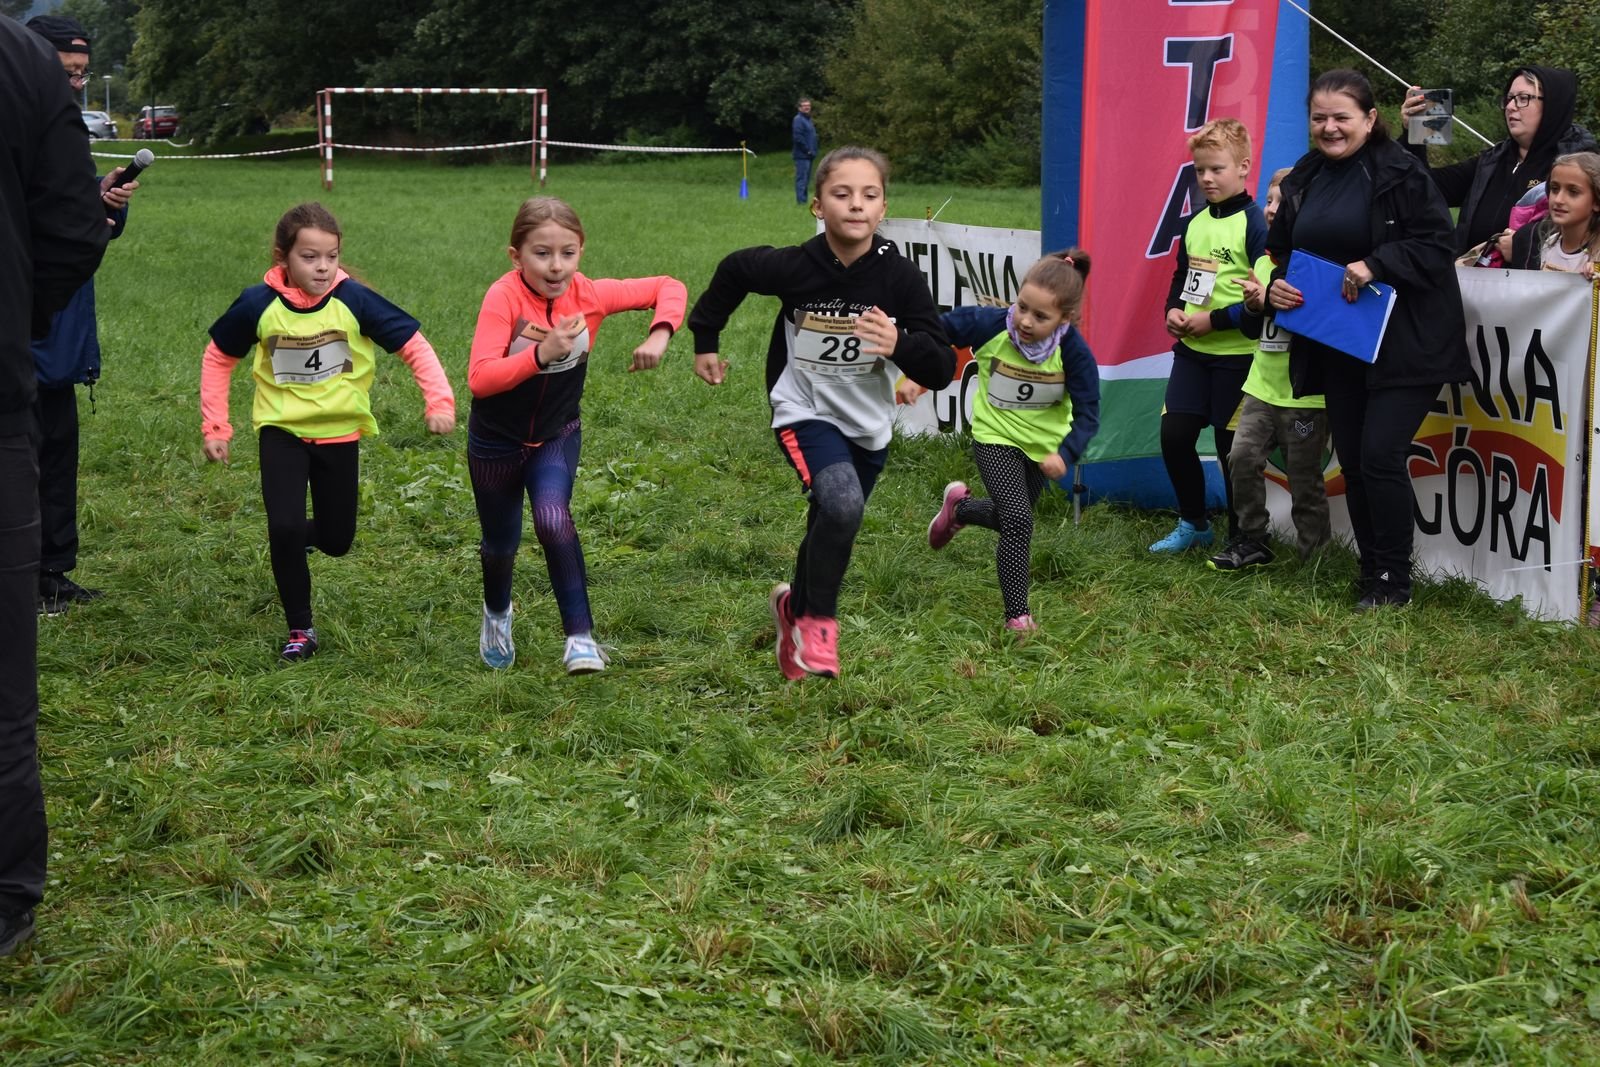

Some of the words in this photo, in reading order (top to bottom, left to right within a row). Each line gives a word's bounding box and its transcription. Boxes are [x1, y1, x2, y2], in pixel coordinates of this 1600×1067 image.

[304, 349, 323, 371] 4
[818, 336, 861, 363] 28
[1016, 383, 1034, 402] 9
